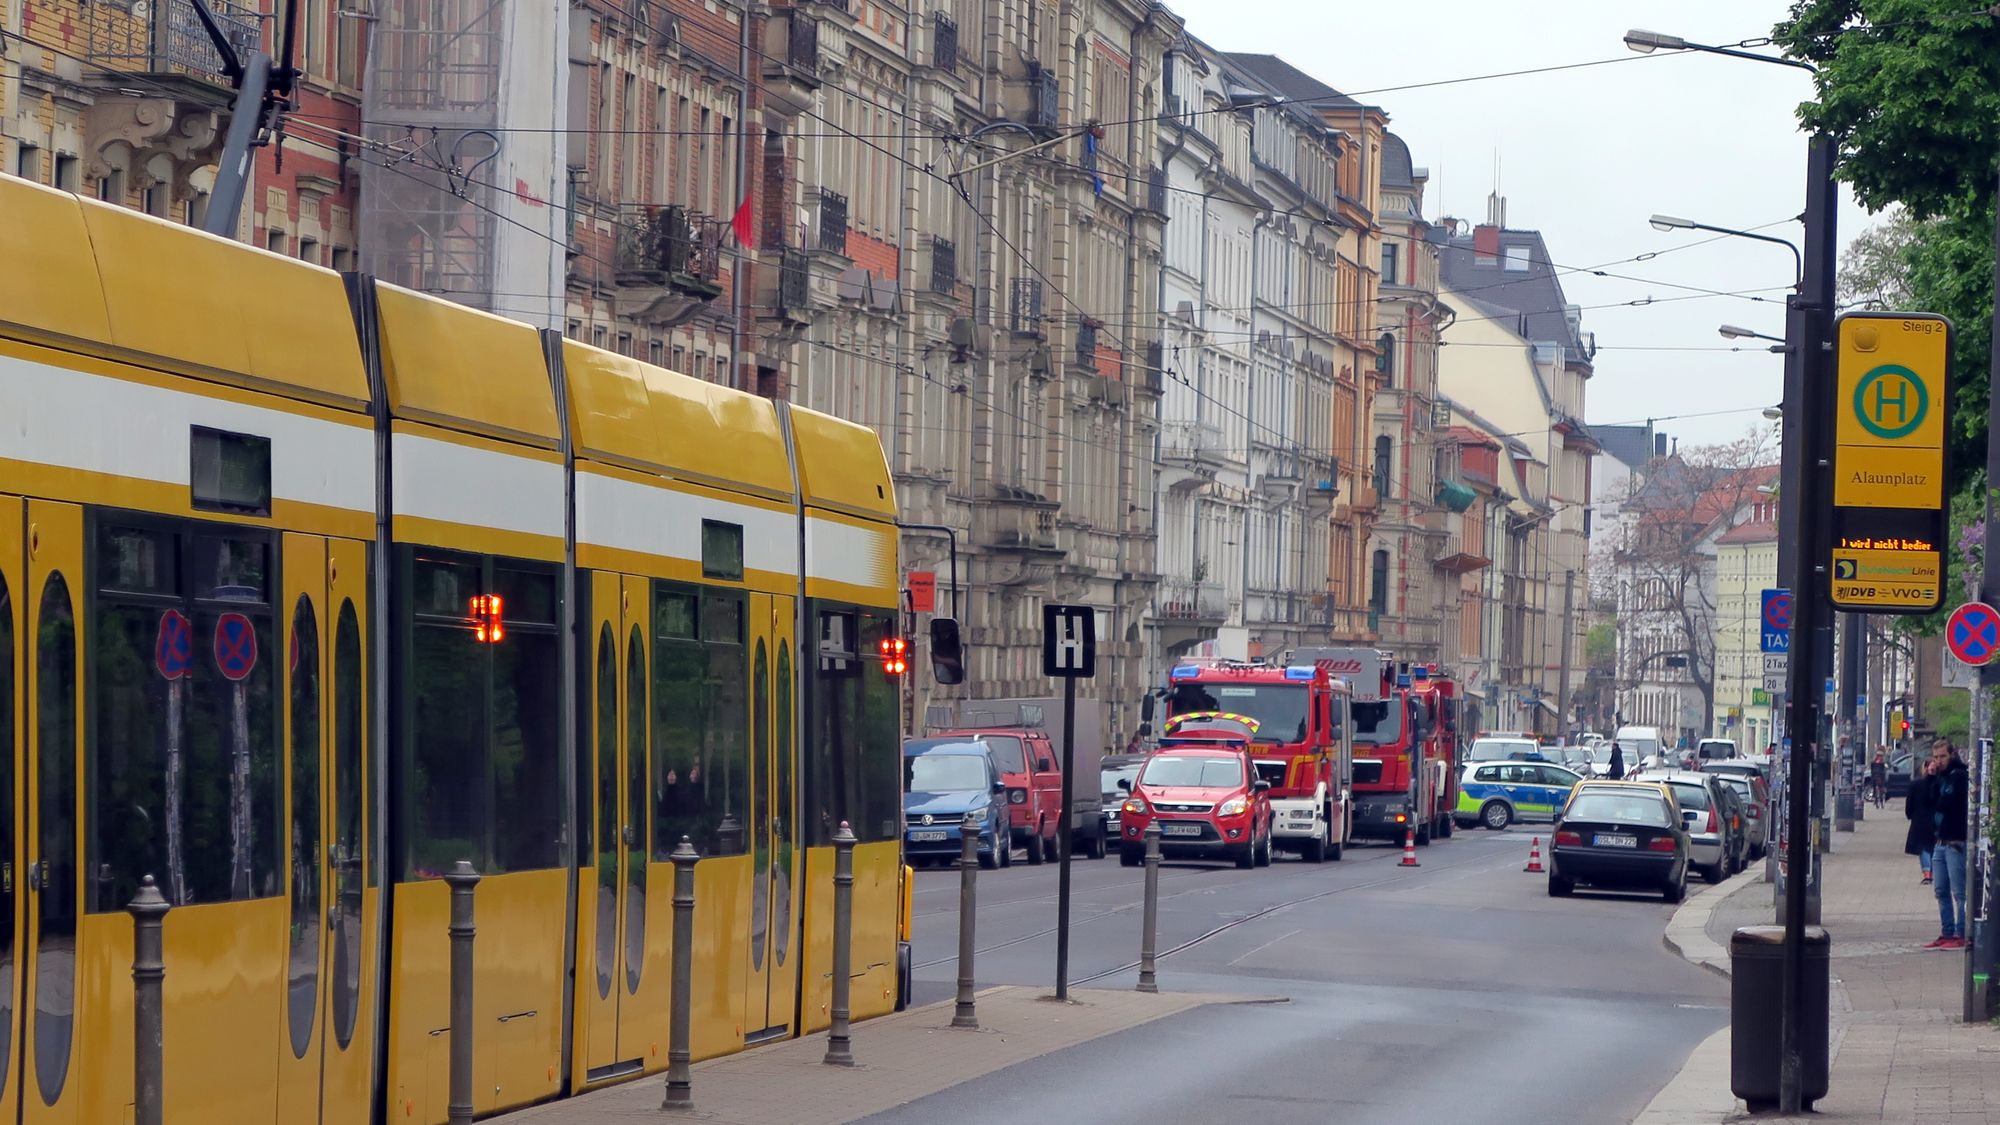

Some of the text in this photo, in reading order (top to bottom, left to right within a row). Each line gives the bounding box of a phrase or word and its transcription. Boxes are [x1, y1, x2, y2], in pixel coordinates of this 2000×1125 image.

[1902, 321, 1943, 334] Steig 2
[1875, 380, 1907, 423] H
[1851, 471, 1927, 487] Alaunplatz
[1849, 538, 1871, 549] wird
[1874, 538, 1899, 550] nicht
[1850, 587, 1876, 597] DVB
[1892, 588, 1921, 598] VVO
[1055, 615, 1083, 669] H
[1314, 658, 1362, 673] Metz
[1766, 660, 1771, 668] 2
[1767, 679, 1777, 689] 20
